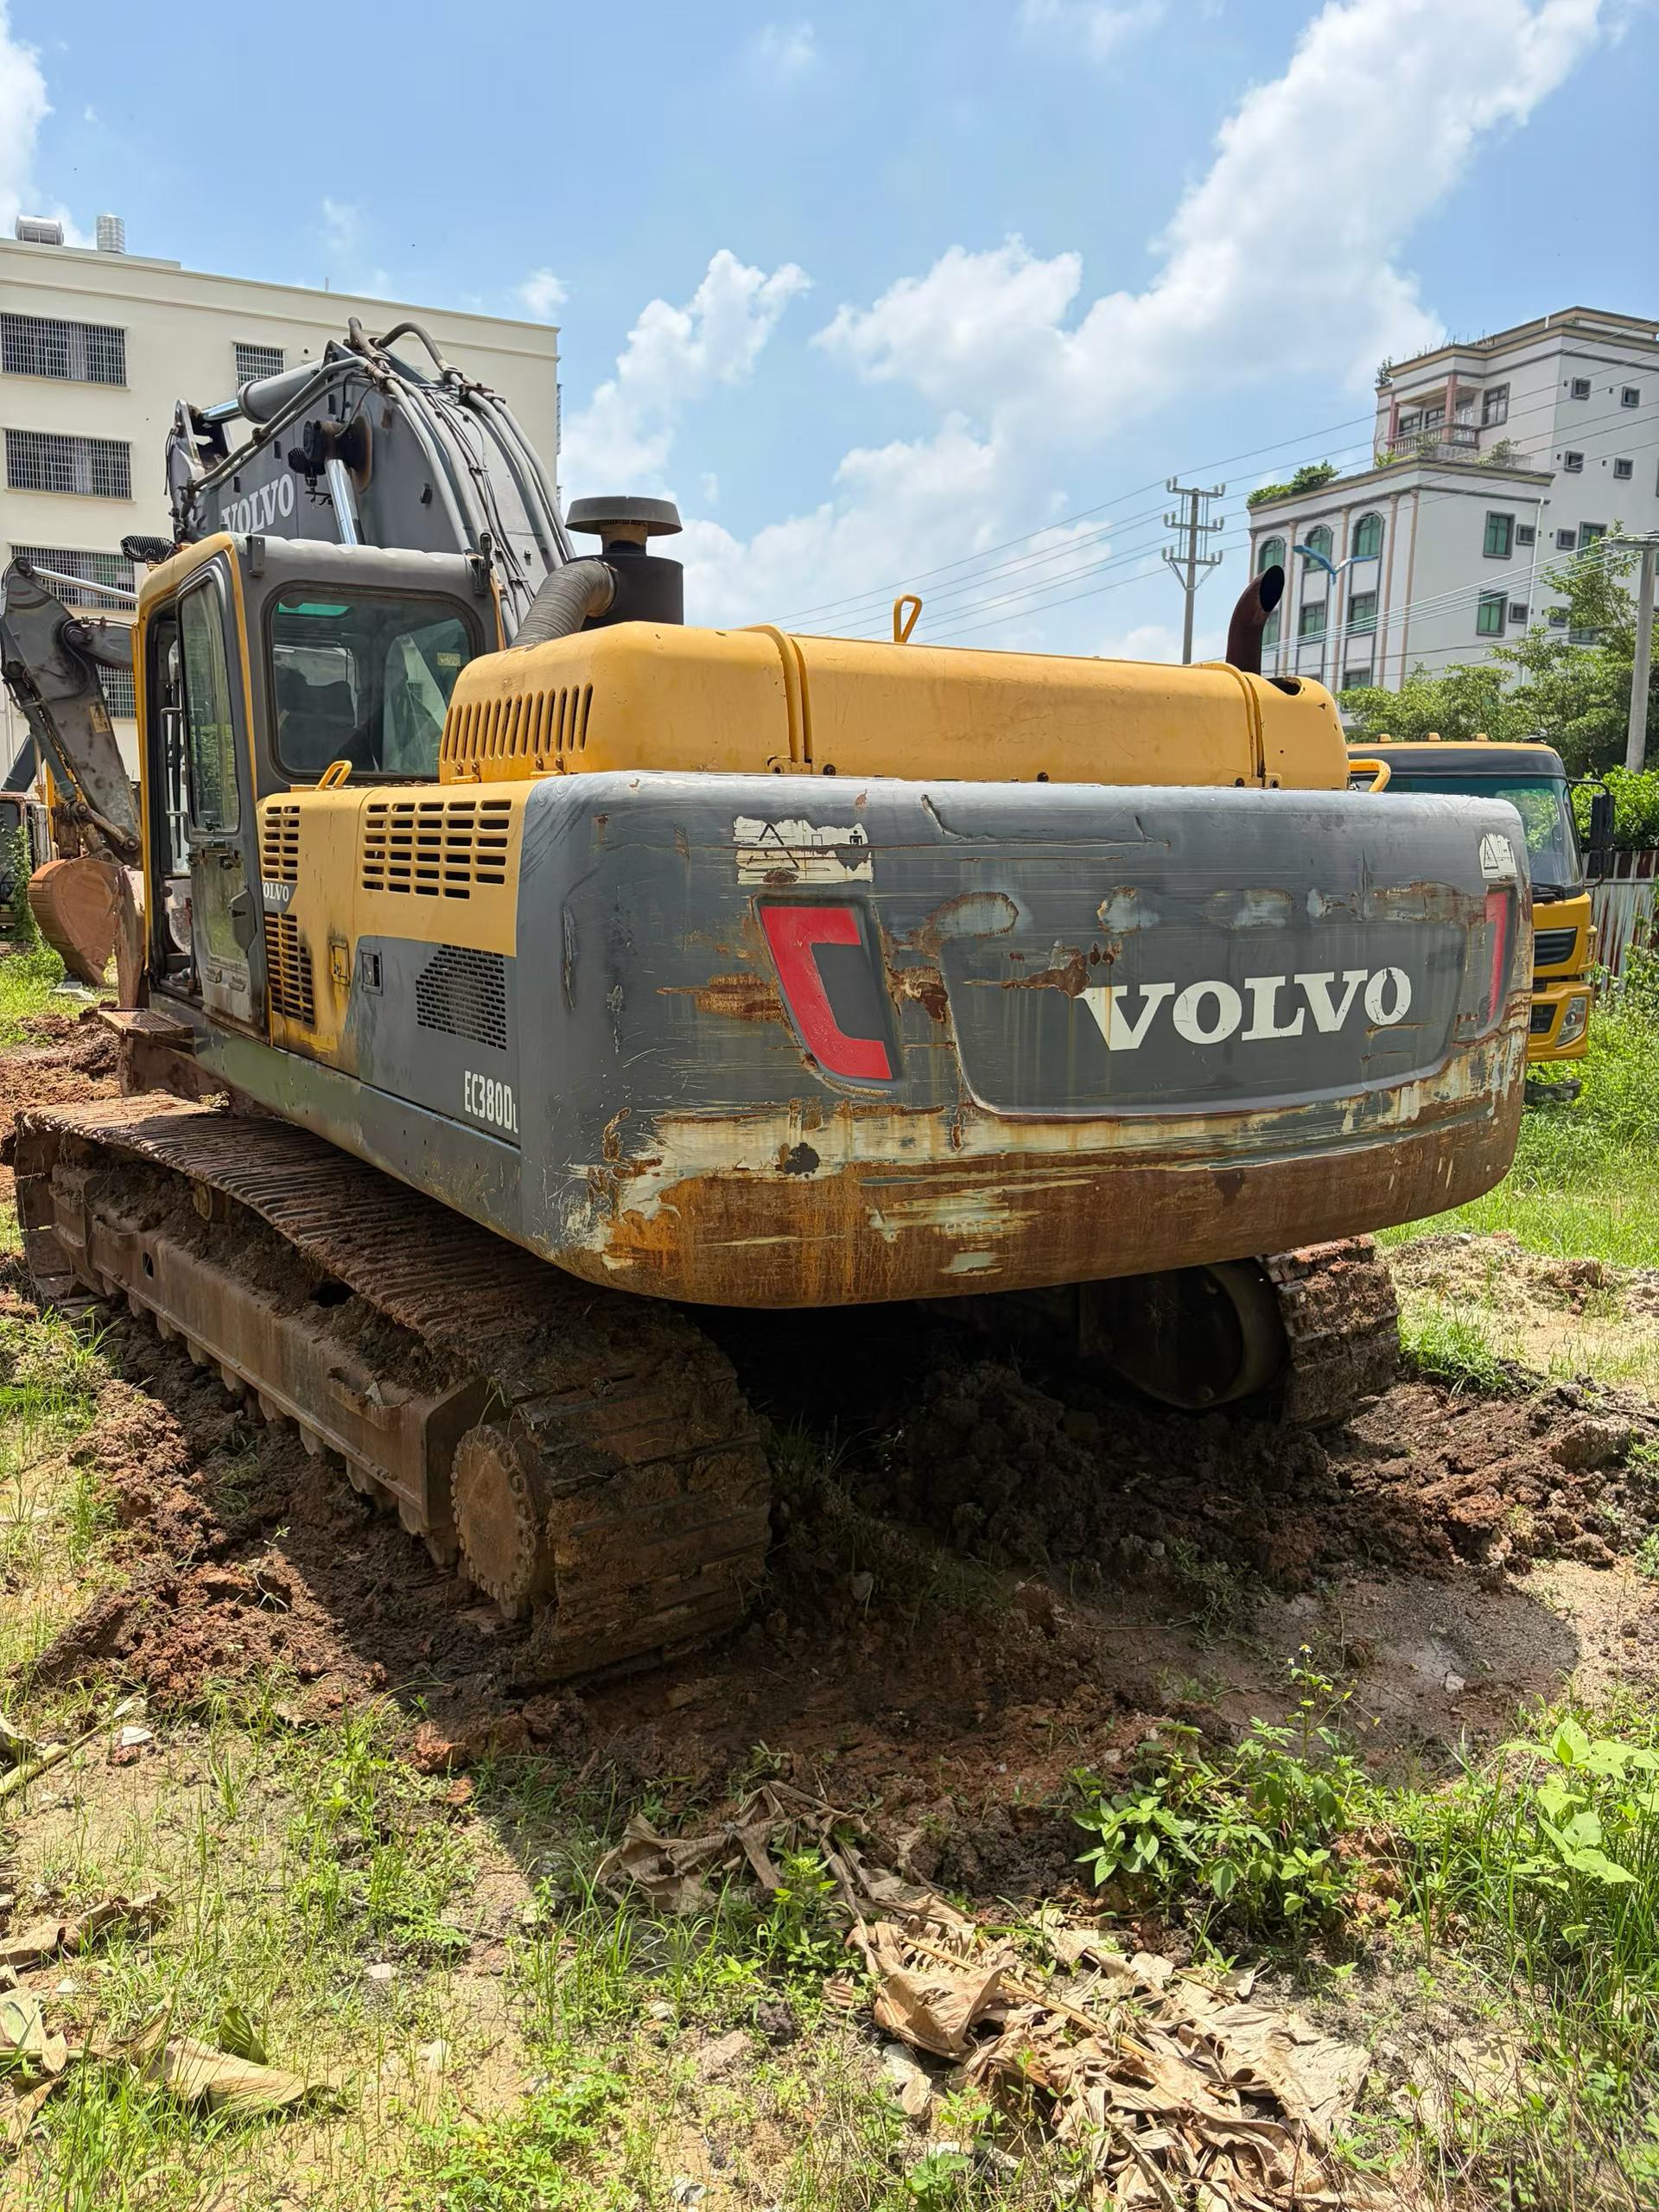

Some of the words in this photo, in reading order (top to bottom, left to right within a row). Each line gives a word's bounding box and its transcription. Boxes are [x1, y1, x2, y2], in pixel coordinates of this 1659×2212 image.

[220, 474, 295, 534] VOLVO
[262, 881, 289, 902] OLVO
[1075, 966, 1412, 1052] VOLVO
